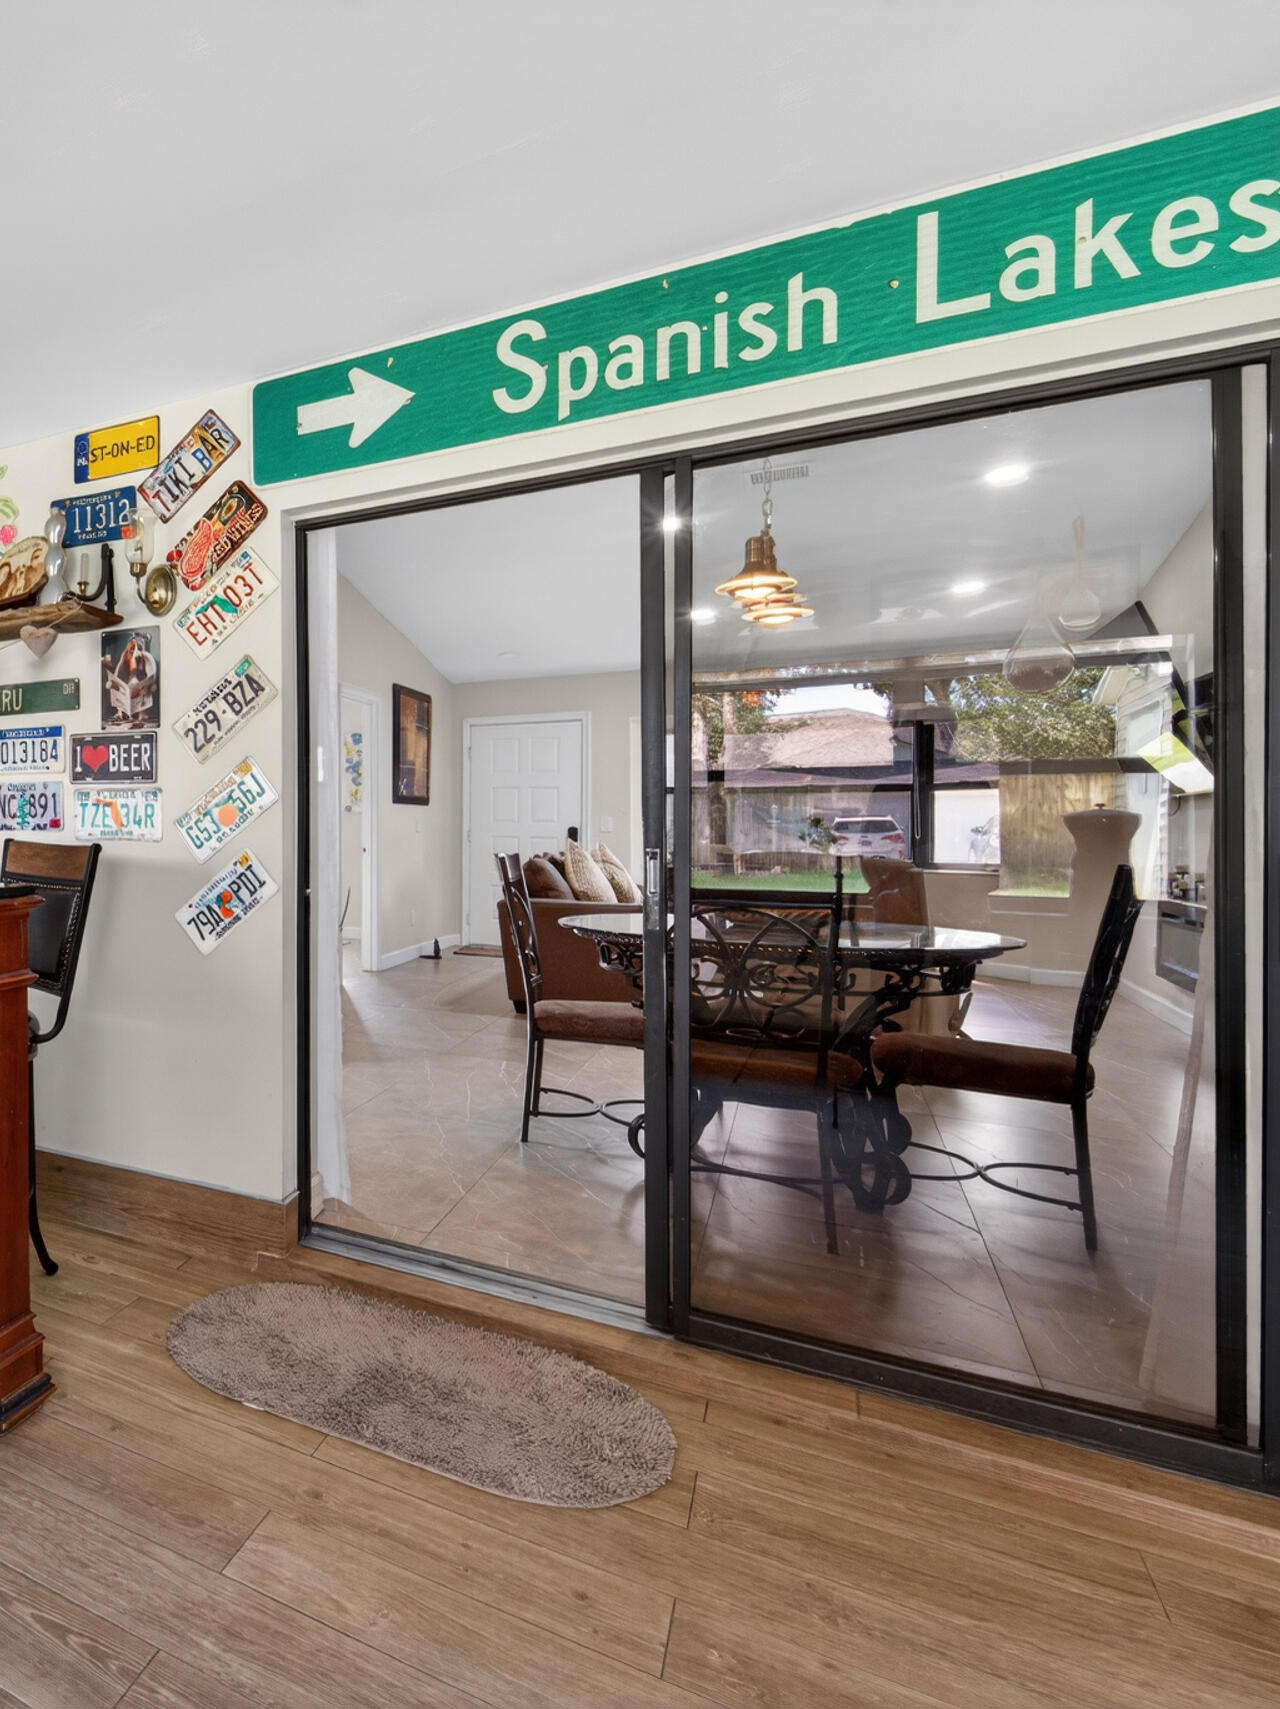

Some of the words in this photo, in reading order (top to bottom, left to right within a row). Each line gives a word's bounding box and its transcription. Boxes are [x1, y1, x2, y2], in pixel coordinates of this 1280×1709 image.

[492, 271, 838, 421] Spanish
[915, 179, 1280, 324] Lakes
[90, 435, 155, 463] ST-ON-ED
[152, 457, 195, 512] TIKI
[191, 427, 230, 473] BAR
[74, 746, 82, 772] I
[109, 743, 151, 772] BEER
